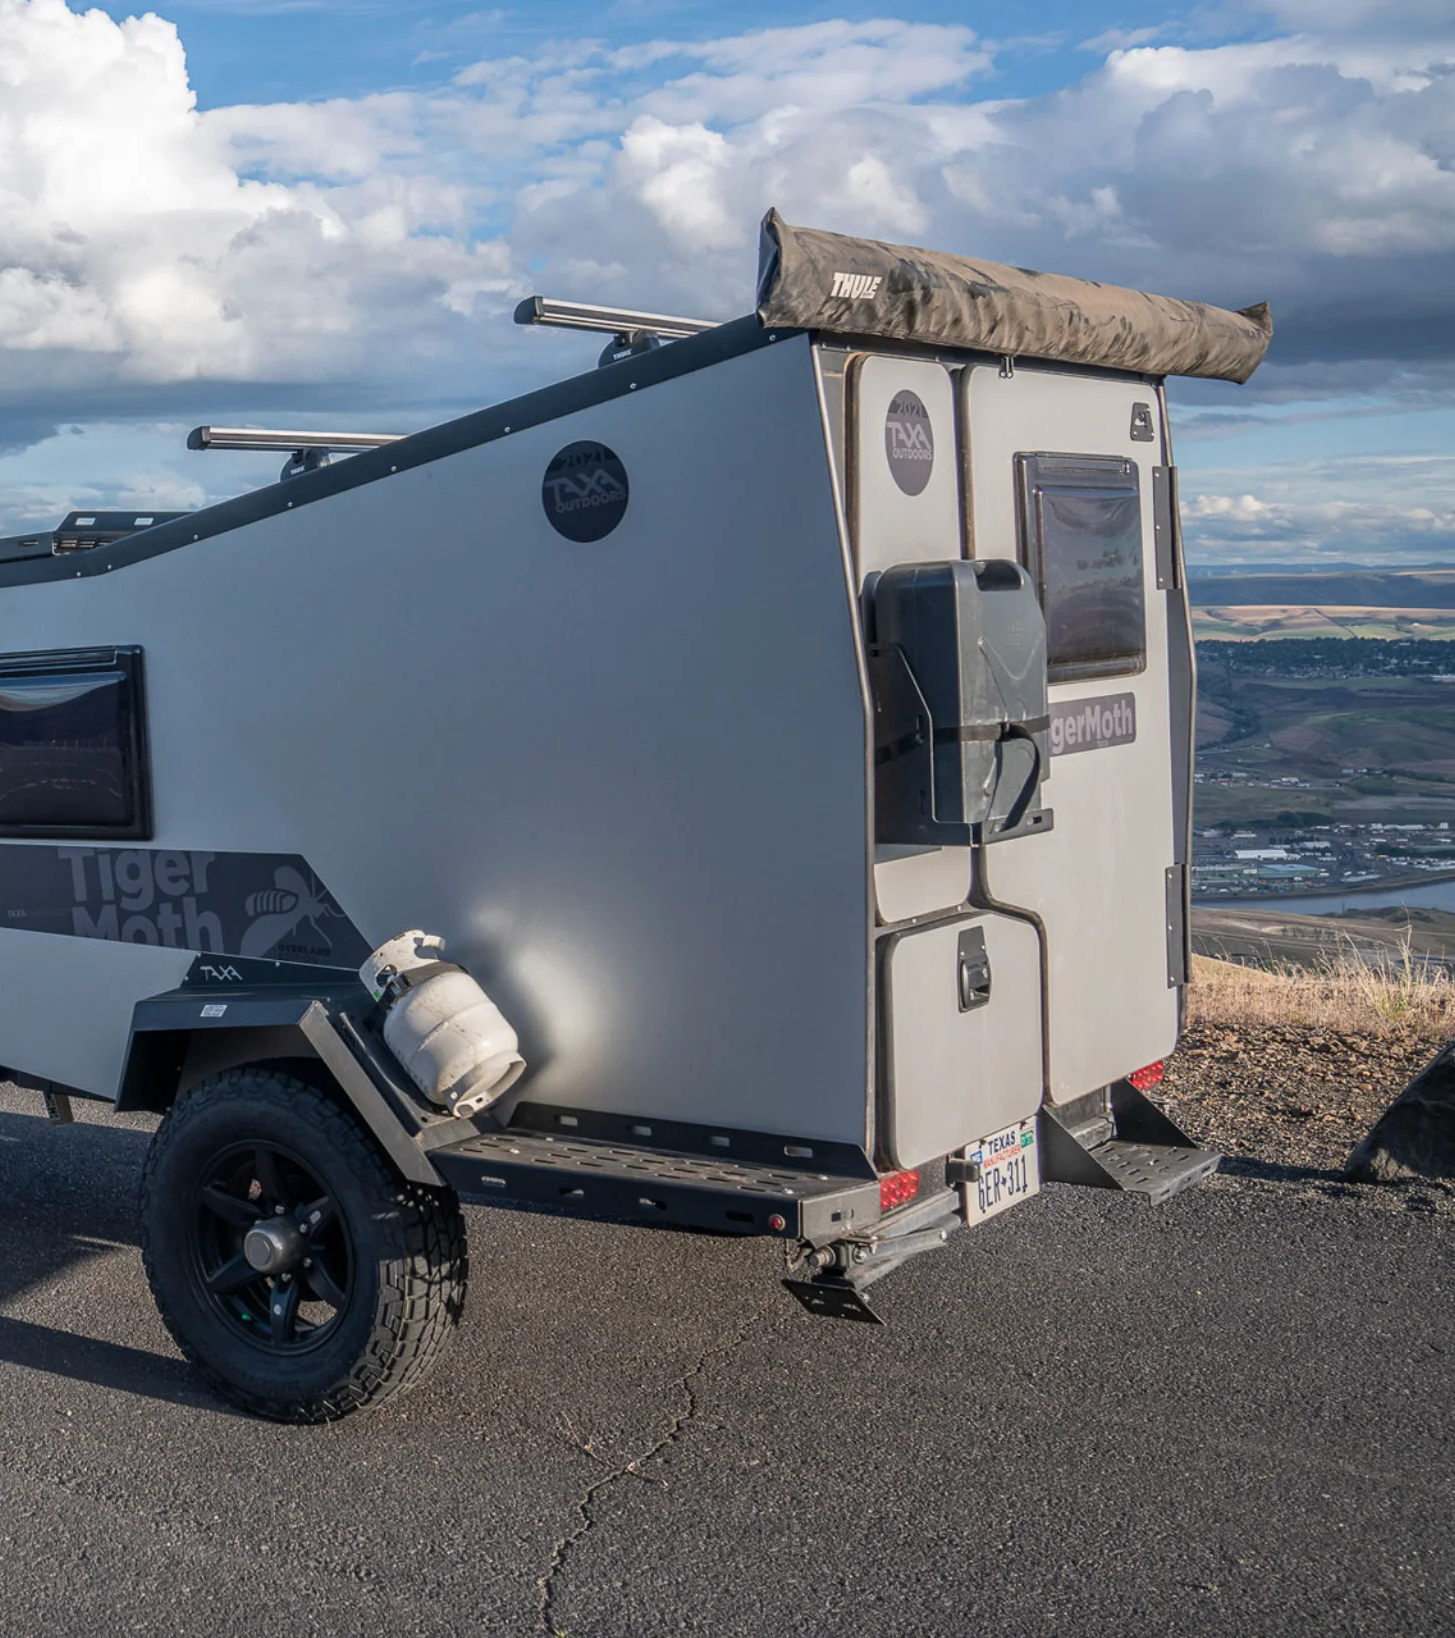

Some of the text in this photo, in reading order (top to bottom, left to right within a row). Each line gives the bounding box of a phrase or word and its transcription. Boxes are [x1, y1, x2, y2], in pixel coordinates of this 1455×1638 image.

[830, 272, 883, 299] THULE
[886, 421, 933, 450] TAXA
[892, 448, 933, 461] OUTDOORS
[545, 467, 626, 505] TAXA
[556, 488, 626, 514] OUTDOORS
[1050, 700, 1134, 755] gerMoth
[57, 846, 216, 912] Tiger
[70, 896, 226, 954] Moth
[200, 965, 244, 981] TAXA
[988, 1131, 1016, 1155] TEXAS
